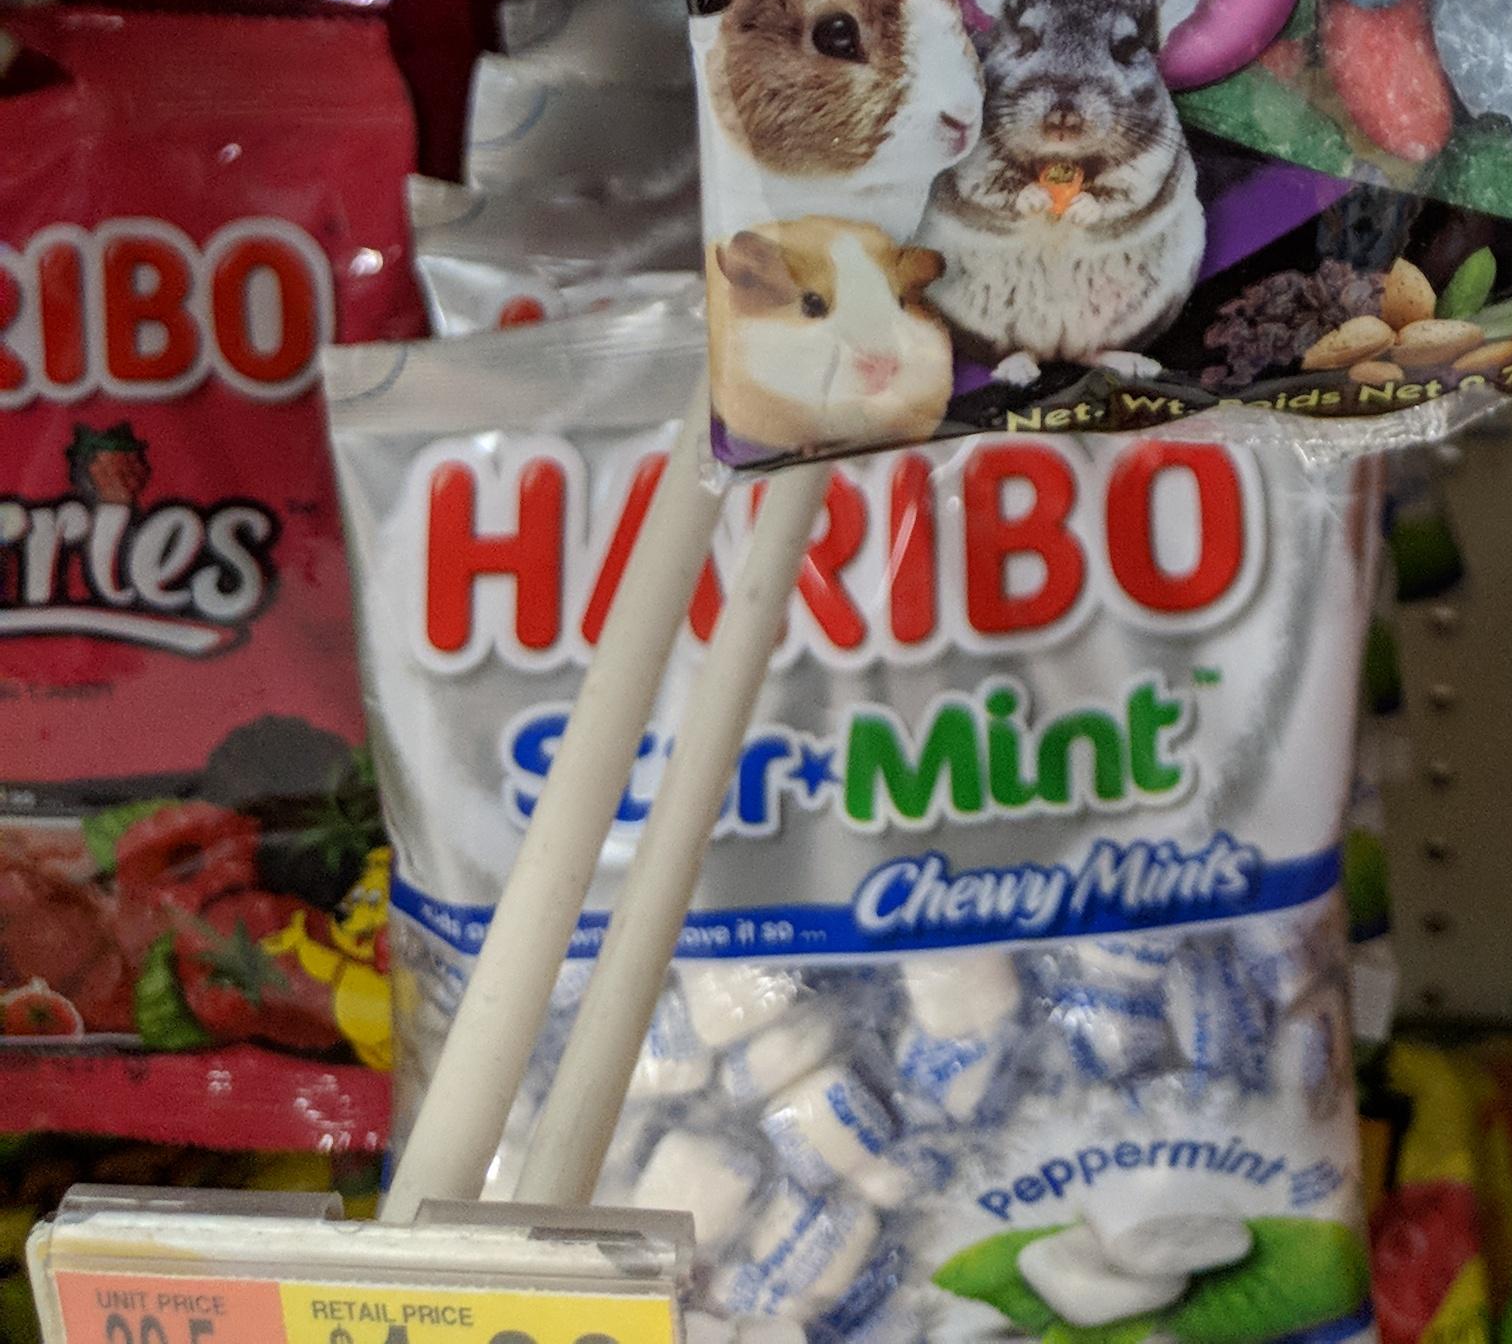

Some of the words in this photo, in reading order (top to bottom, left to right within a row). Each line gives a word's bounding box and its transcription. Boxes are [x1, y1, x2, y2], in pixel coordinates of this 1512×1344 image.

[1358, 377, 1443, 405] Net
[845, 680, 1184, 824] Mint
[860, 850, 1074, 931] Chewy
[1076, 832, 1264, 910] Mints
[677, 924, 732, 946] ove
[96, 1289, 155, 1313] UNIT
[157, 1291, 226, 1316] PRICE
[311, 1299, 396, 1325] RETAIL
[401, 1303, 475, 1327] PRICE
